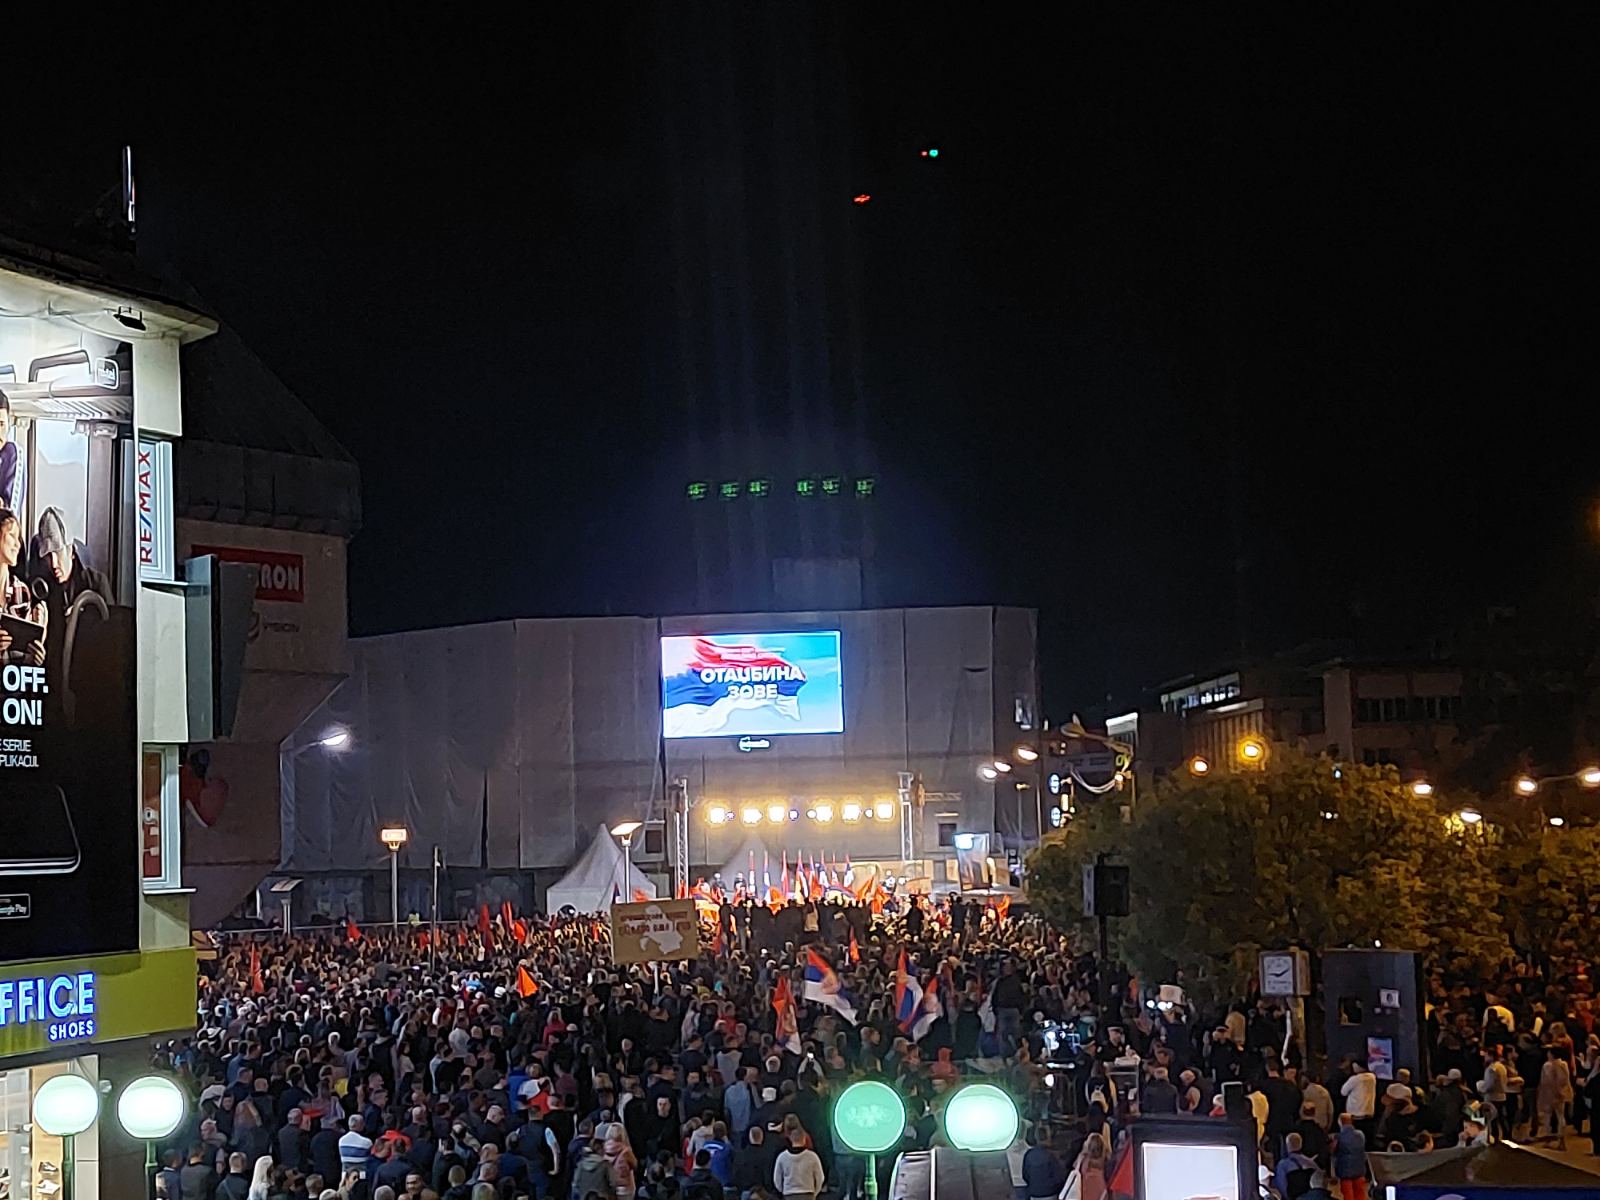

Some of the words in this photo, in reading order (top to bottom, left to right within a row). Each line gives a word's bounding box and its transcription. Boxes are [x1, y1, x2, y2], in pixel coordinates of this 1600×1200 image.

[139, 451, 152, 563] RE/MAX
[3, 664, 48, 693] OFF.
[727, 684, 778, 699] ЗОВЕ
[3, 698, 42, 725] ON!
[0, 973, 94, 1025] FFICE
[50, 1020, 94, 1040] SHOES
